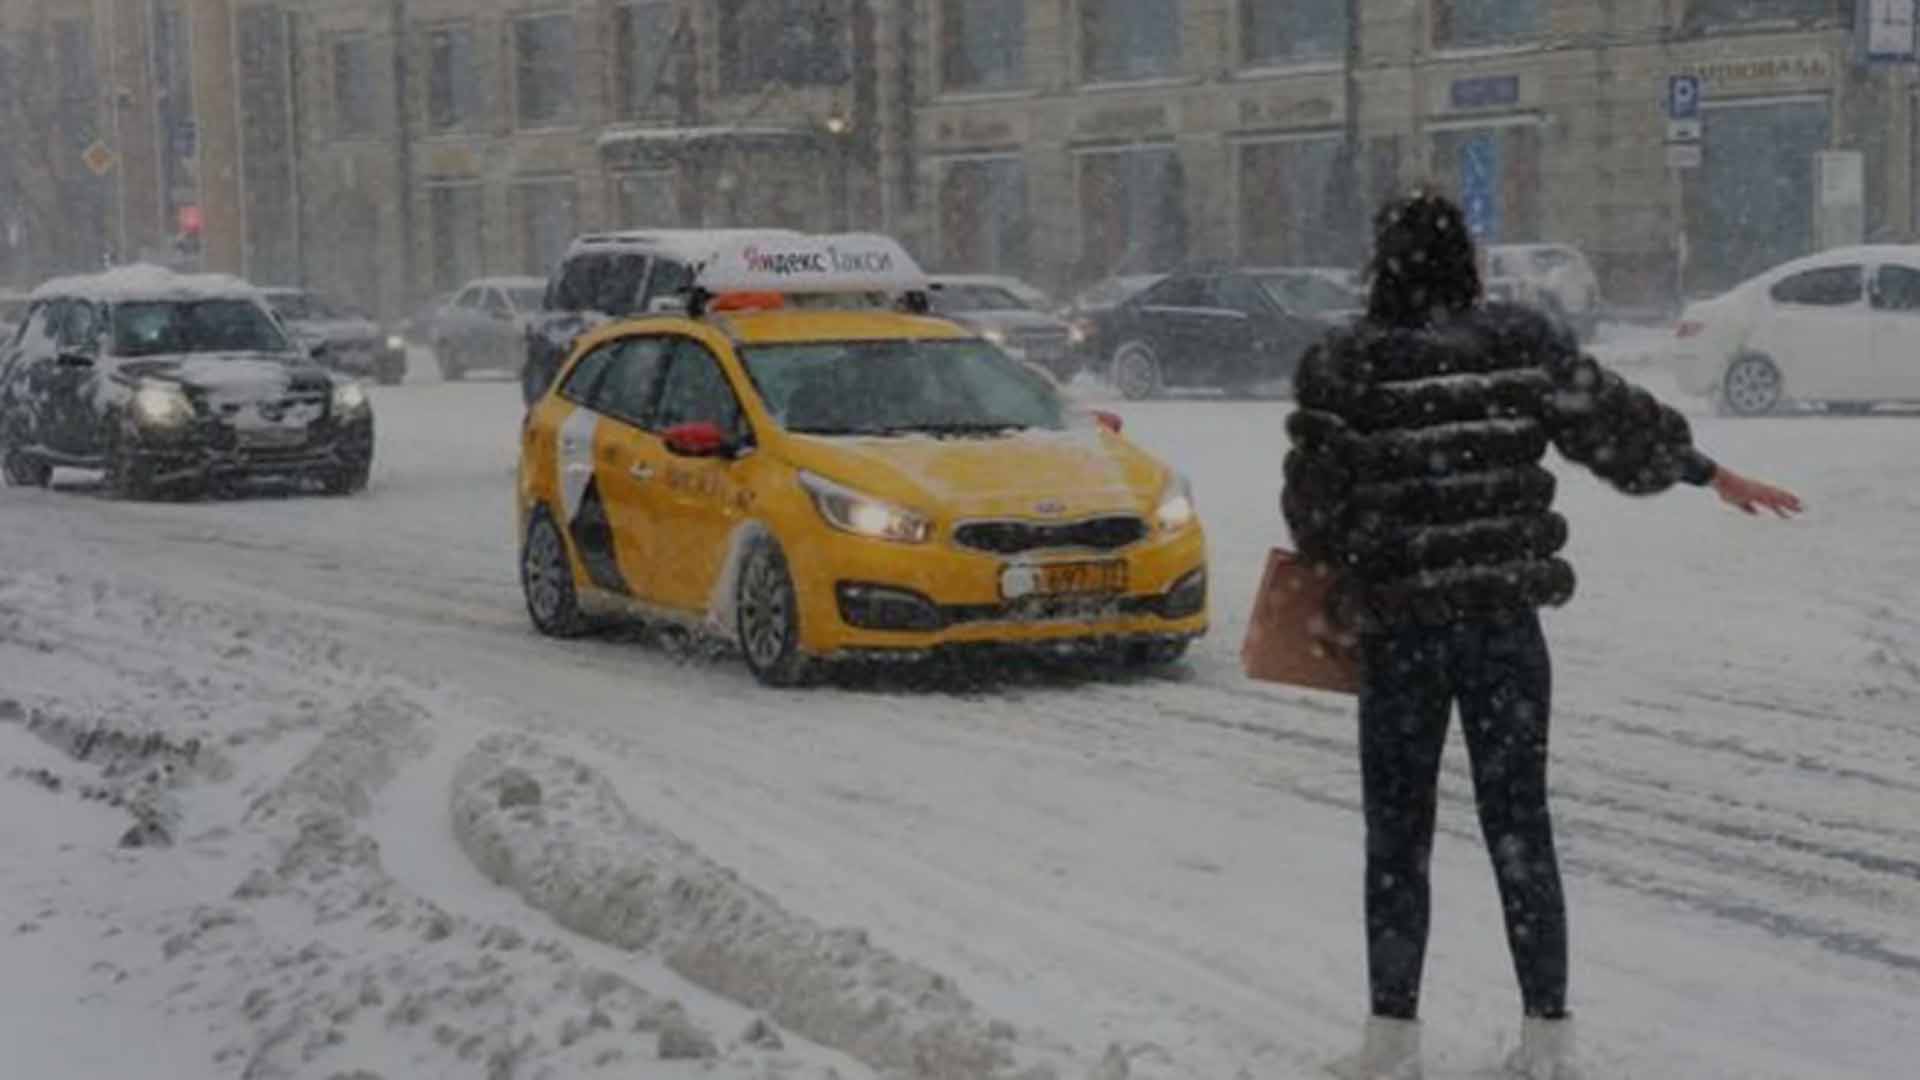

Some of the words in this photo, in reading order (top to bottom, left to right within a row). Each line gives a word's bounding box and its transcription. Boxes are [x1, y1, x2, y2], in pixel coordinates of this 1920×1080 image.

[1673, 79, 1695, 115] P
[744, 247, 827, 275] Яндекс
[828, 247, 895, 273] Такси
